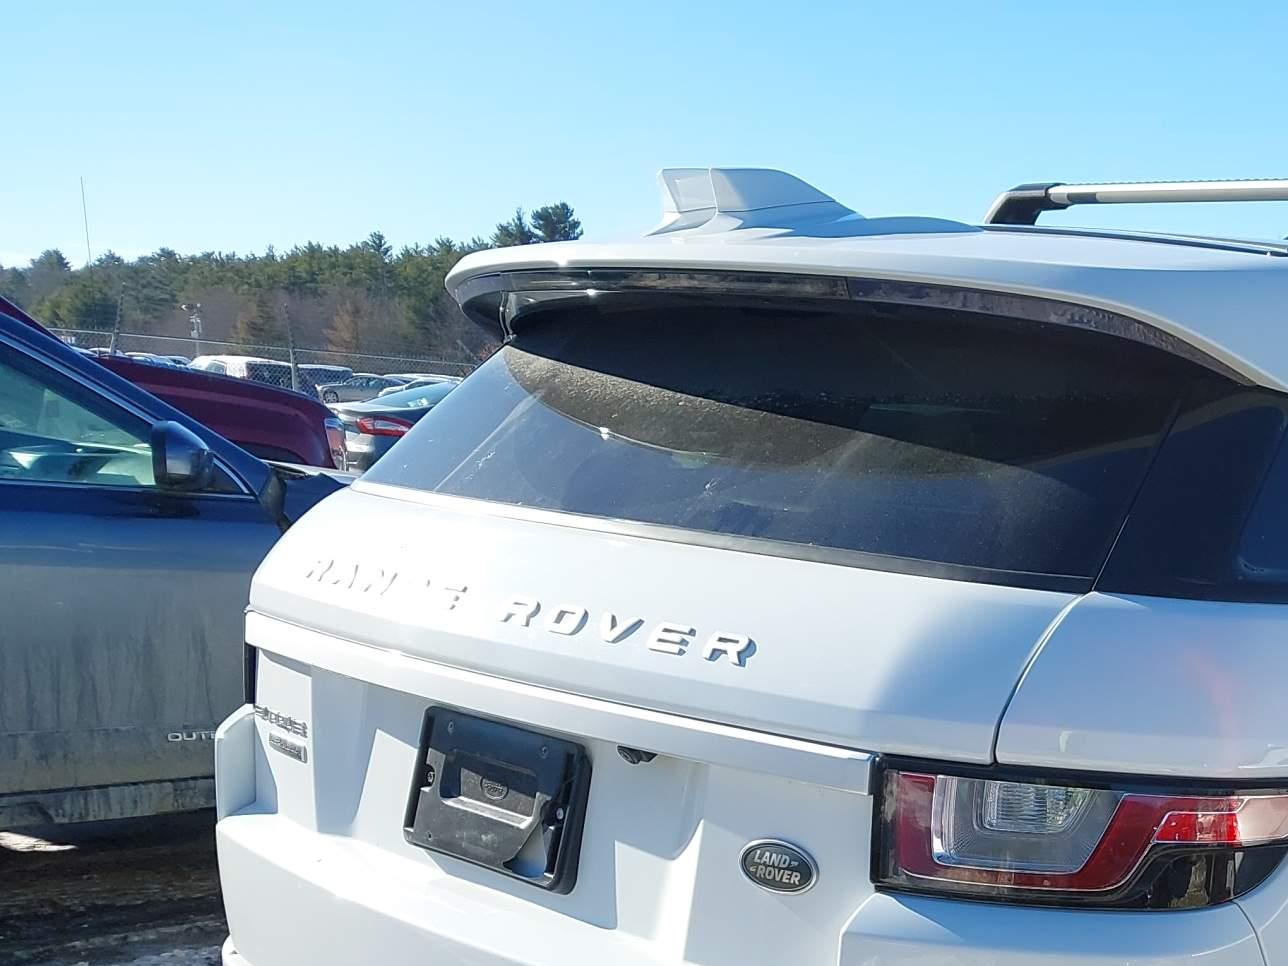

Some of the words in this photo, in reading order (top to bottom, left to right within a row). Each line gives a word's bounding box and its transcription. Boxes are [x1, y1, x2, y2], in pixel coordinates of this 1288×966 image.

[499, 598, 757, 668] ROVER
[754, 849, 790, 868] LAND
[756, 865, 801, 885] ROVER
